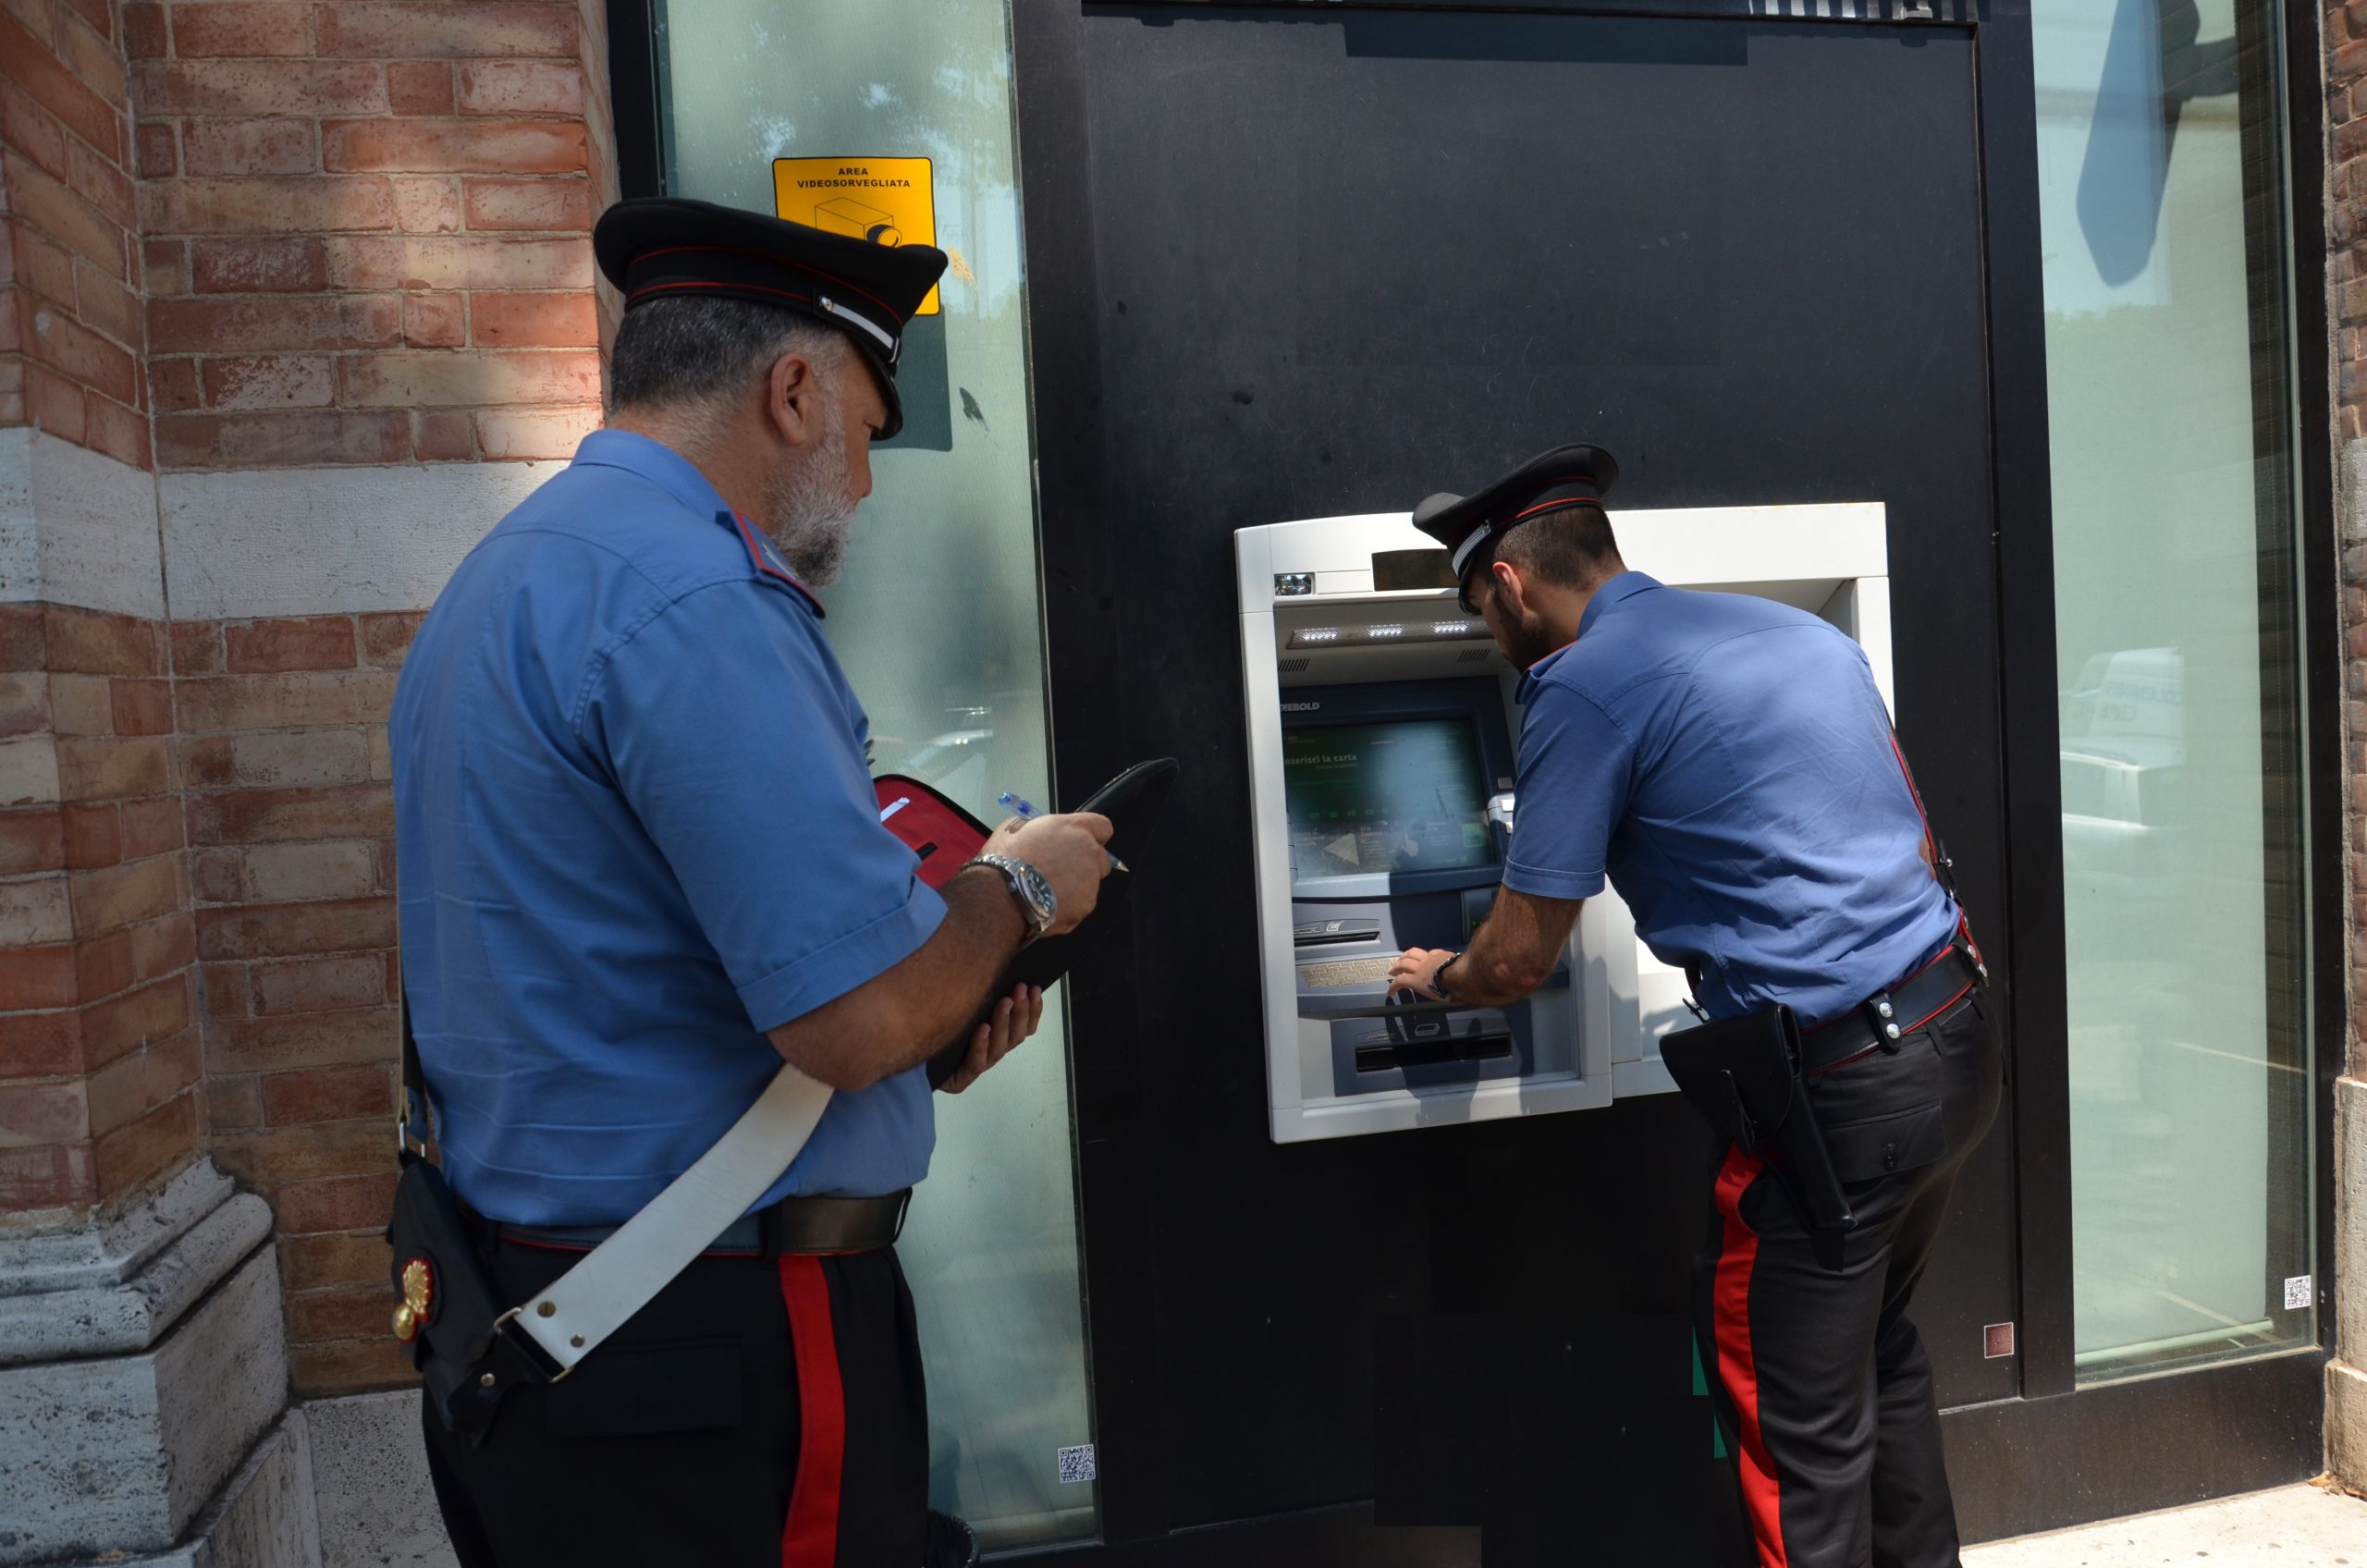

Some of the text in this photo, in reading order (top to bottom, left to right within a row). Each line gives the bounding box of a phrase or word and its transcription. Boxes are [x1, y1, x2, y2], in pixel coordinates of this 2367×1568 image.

[838, 167, 868, 176] AREA
[797, 178, 911, 189] VIDEOSORVEGLIATA
[1284, 753, 1357, 766] nserisci la carta
